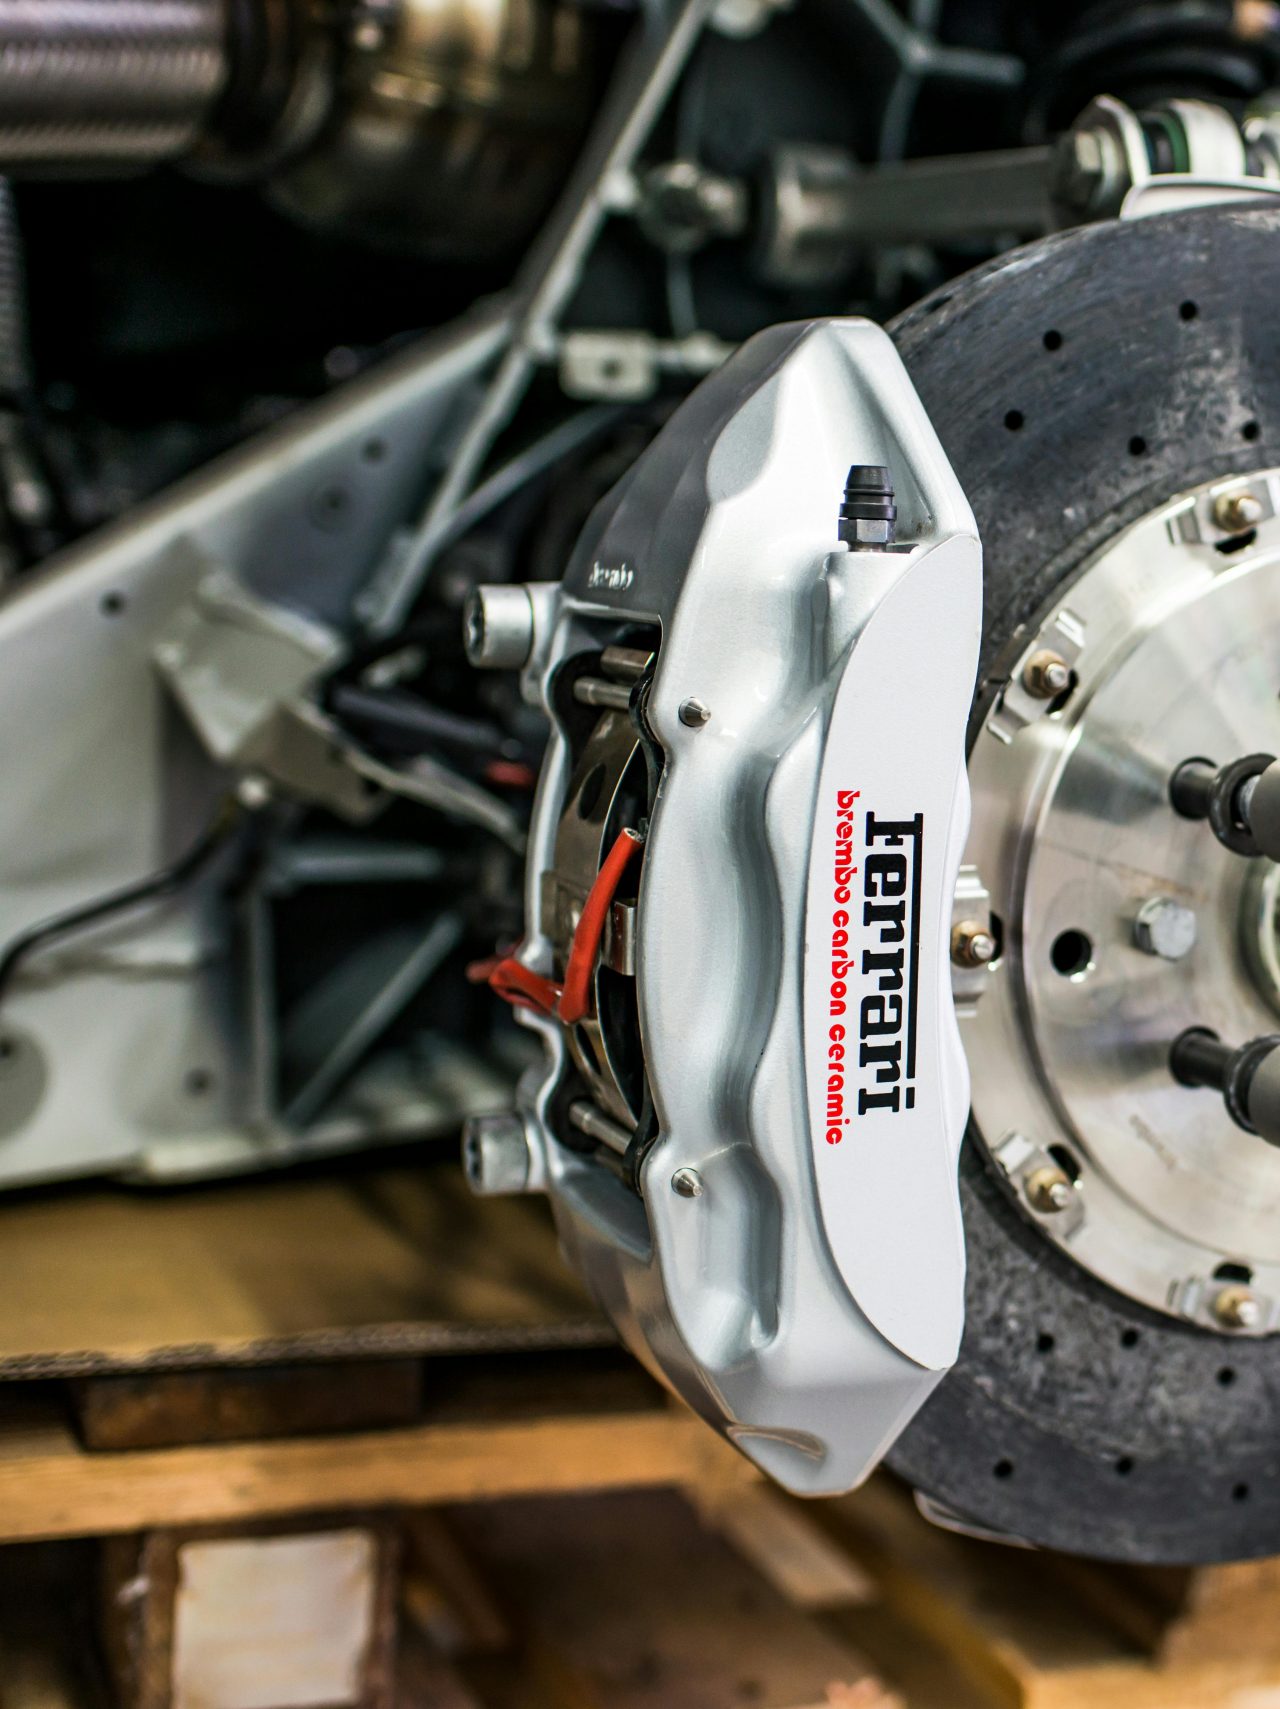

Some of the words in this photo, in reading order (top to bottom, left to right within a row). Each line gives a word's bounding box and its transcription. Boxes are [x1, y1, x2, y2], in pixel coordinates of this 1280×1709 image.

[833, 790, 861, 905] brembo
[829, 909, 855, 1017] carbon
[857, 811, 924, 1116] Ferrari
[825, 1023, 851, 1145] ceramic
